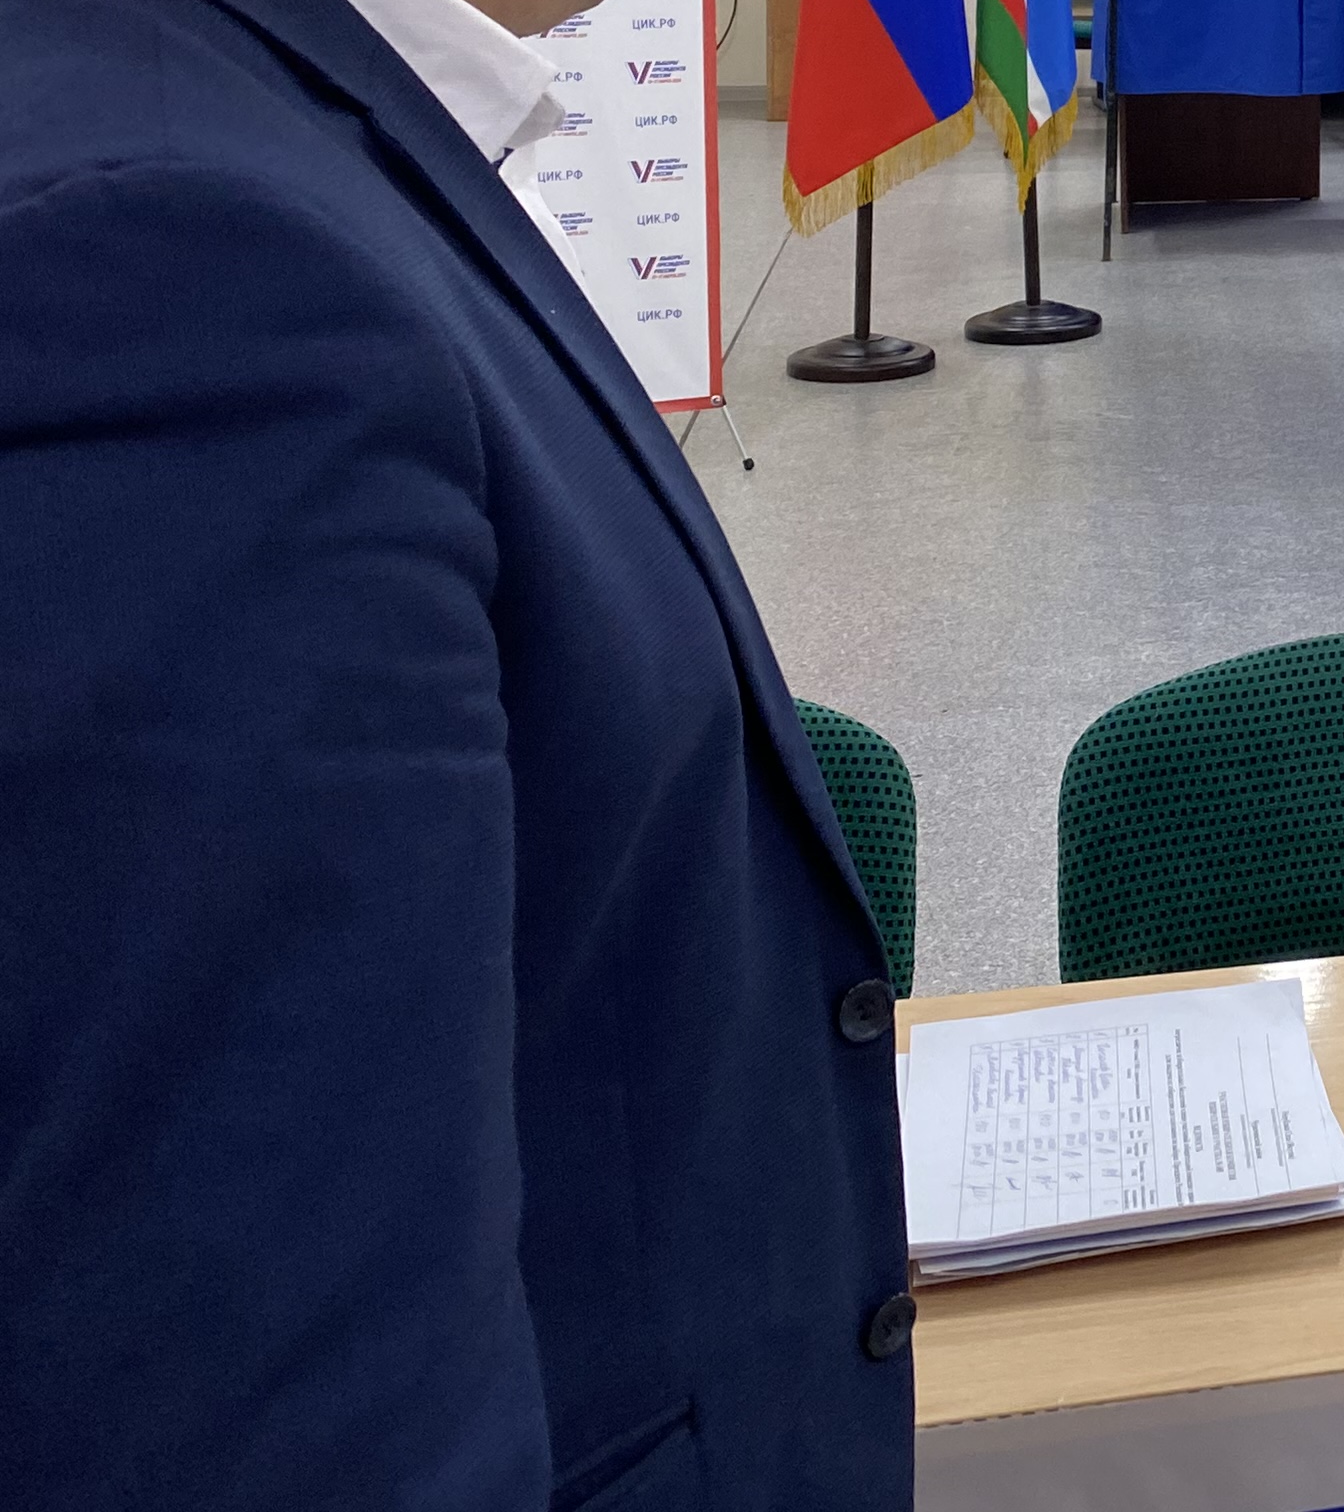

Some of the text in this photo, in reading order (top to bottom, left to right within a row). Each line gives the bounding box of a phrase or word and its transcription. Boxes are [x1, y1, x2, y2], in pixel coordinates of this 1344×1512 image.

[632, 18, 676, 30] ЦИК.РФ
[553, 71, 583, 82] К.РФ
[635, 114, 678, 128] ЦИК.РФ
[537, 169, 583, 183] ЦИК.РФ
[637, 212, 680, 226] ЦИК.РФ
[637, 308, 682, 323] ЦИК.РФ
